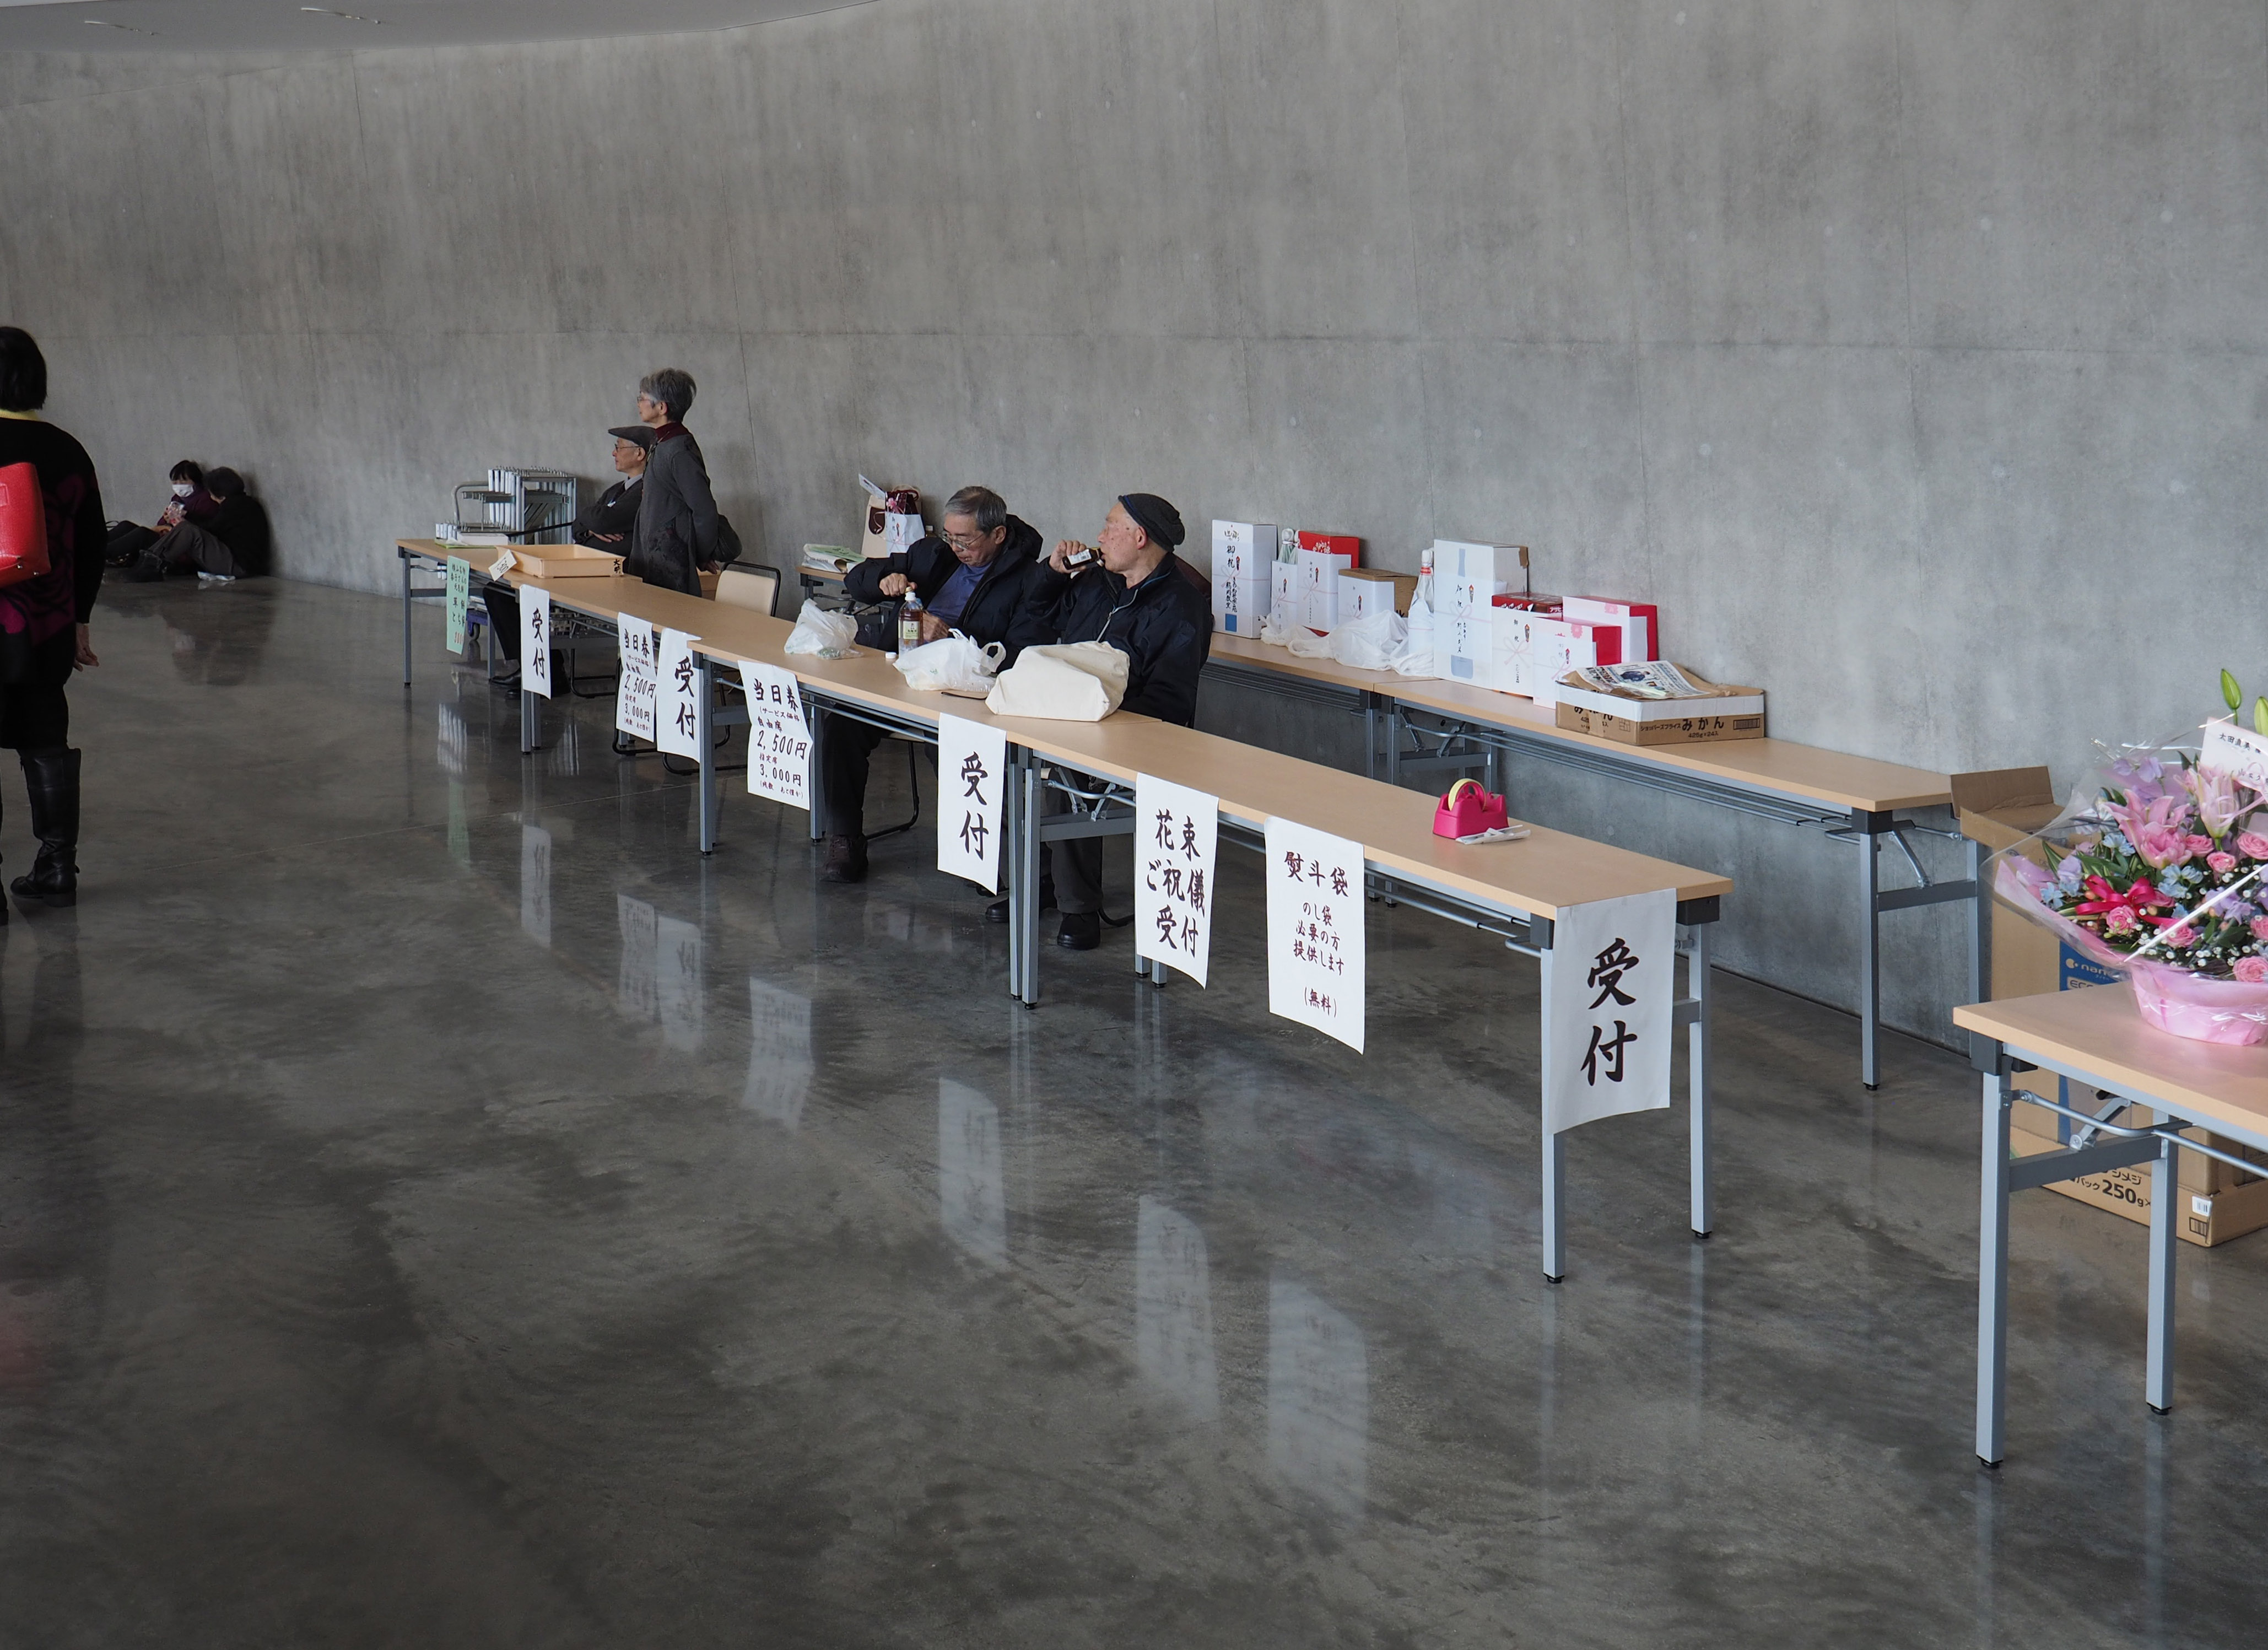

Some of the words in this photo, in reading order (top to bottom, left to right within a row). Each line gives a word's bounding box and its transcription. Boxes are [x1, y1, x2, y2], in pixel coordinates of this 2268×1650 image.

[532, 607, 545, 680] 受付
[624, 628, 650, 659] 当日券
[674, 655, 696, 741] 受付
[753, 677, 799, 713] 当日券
[757, 715, 784, 733] 自由席
[1682, 717, 1724, 731] みかん
[759, 752, 778, 765] 指定席
[959, 751, 990, 861] 受付
[1155, 808, 1201, 862] 花束
[1146, 859, 1206, 919] ご祝儀
[1284, 850, 1349, 898] 熨斗袋
[1156, 904, 1199, 959] 受付
[1295, 919, 1341, 952] 必要の方
[1303, 902, 1332, 928] のし袋
[1293, 939, 1344, 976] 提供します
[1579, 937, 1640, 1087] 受付
